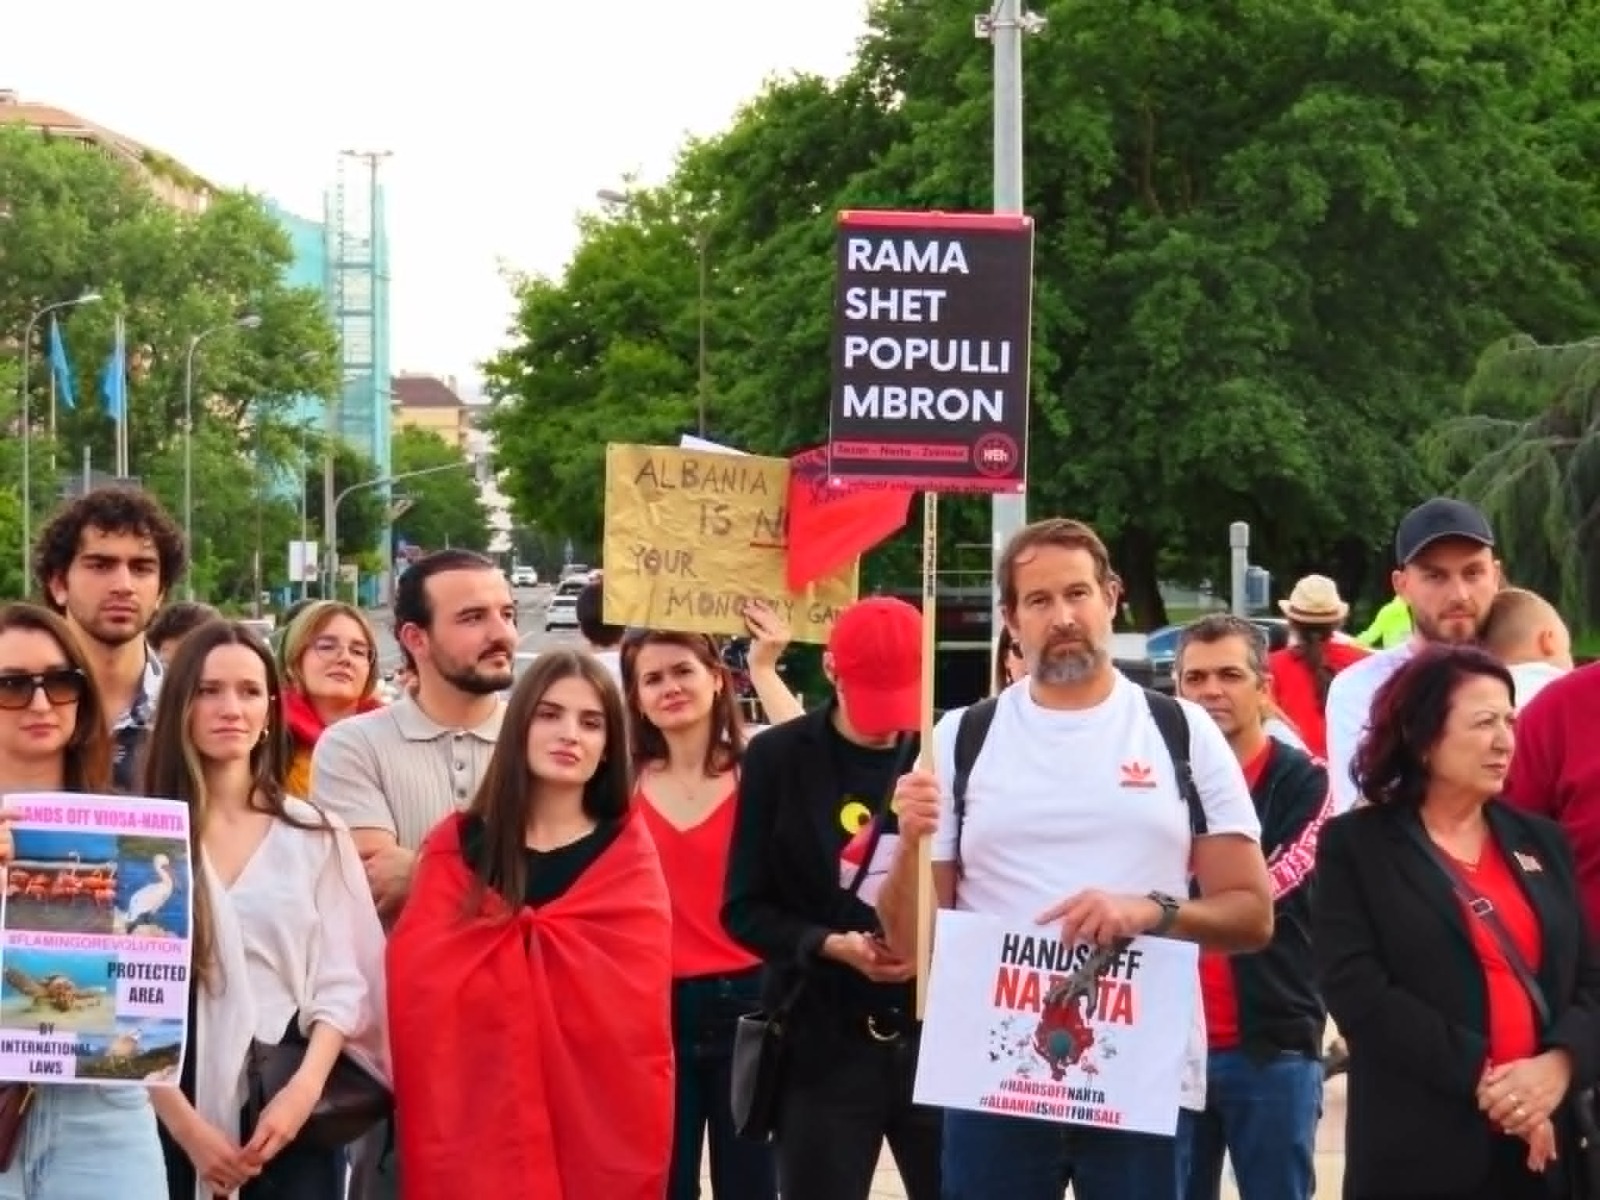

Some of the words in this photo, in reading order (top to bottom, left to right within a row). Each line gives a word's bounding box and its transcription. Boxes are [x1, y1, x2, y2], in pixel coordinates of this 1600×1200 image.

[847, 238, 969, 275] RAMA
[845, 286, 947, 322] SHET
[843, 336, 1011, 374] POPULLI
[842, 384, 1004, 422] MBRON
[634, 459, 768, 495] ALBANIA
[700, 503, 732, 537] IS
[628, 543, 698, 579] YOUR
[19, 805, 64, 824] ANDS
[67, 807, 91, 826] OFF
[8, 933, 183, 954] #FLAMINGOREVOLUTION
[107, 962, 187, 982] PROTECTED
[128, 986, 165, 1004] AREA
[39, 1022, 55, 1036] BY
[1, 1040, 92, 1056] INTERNATIONAL
[29, 1060, 63, 1075] LAWS
[1000, 1078, 1106, 1104] #HANDSOFFNARTA
[979, 1094, 1122, 1125] #ALBANIAISNOTFORSALE
